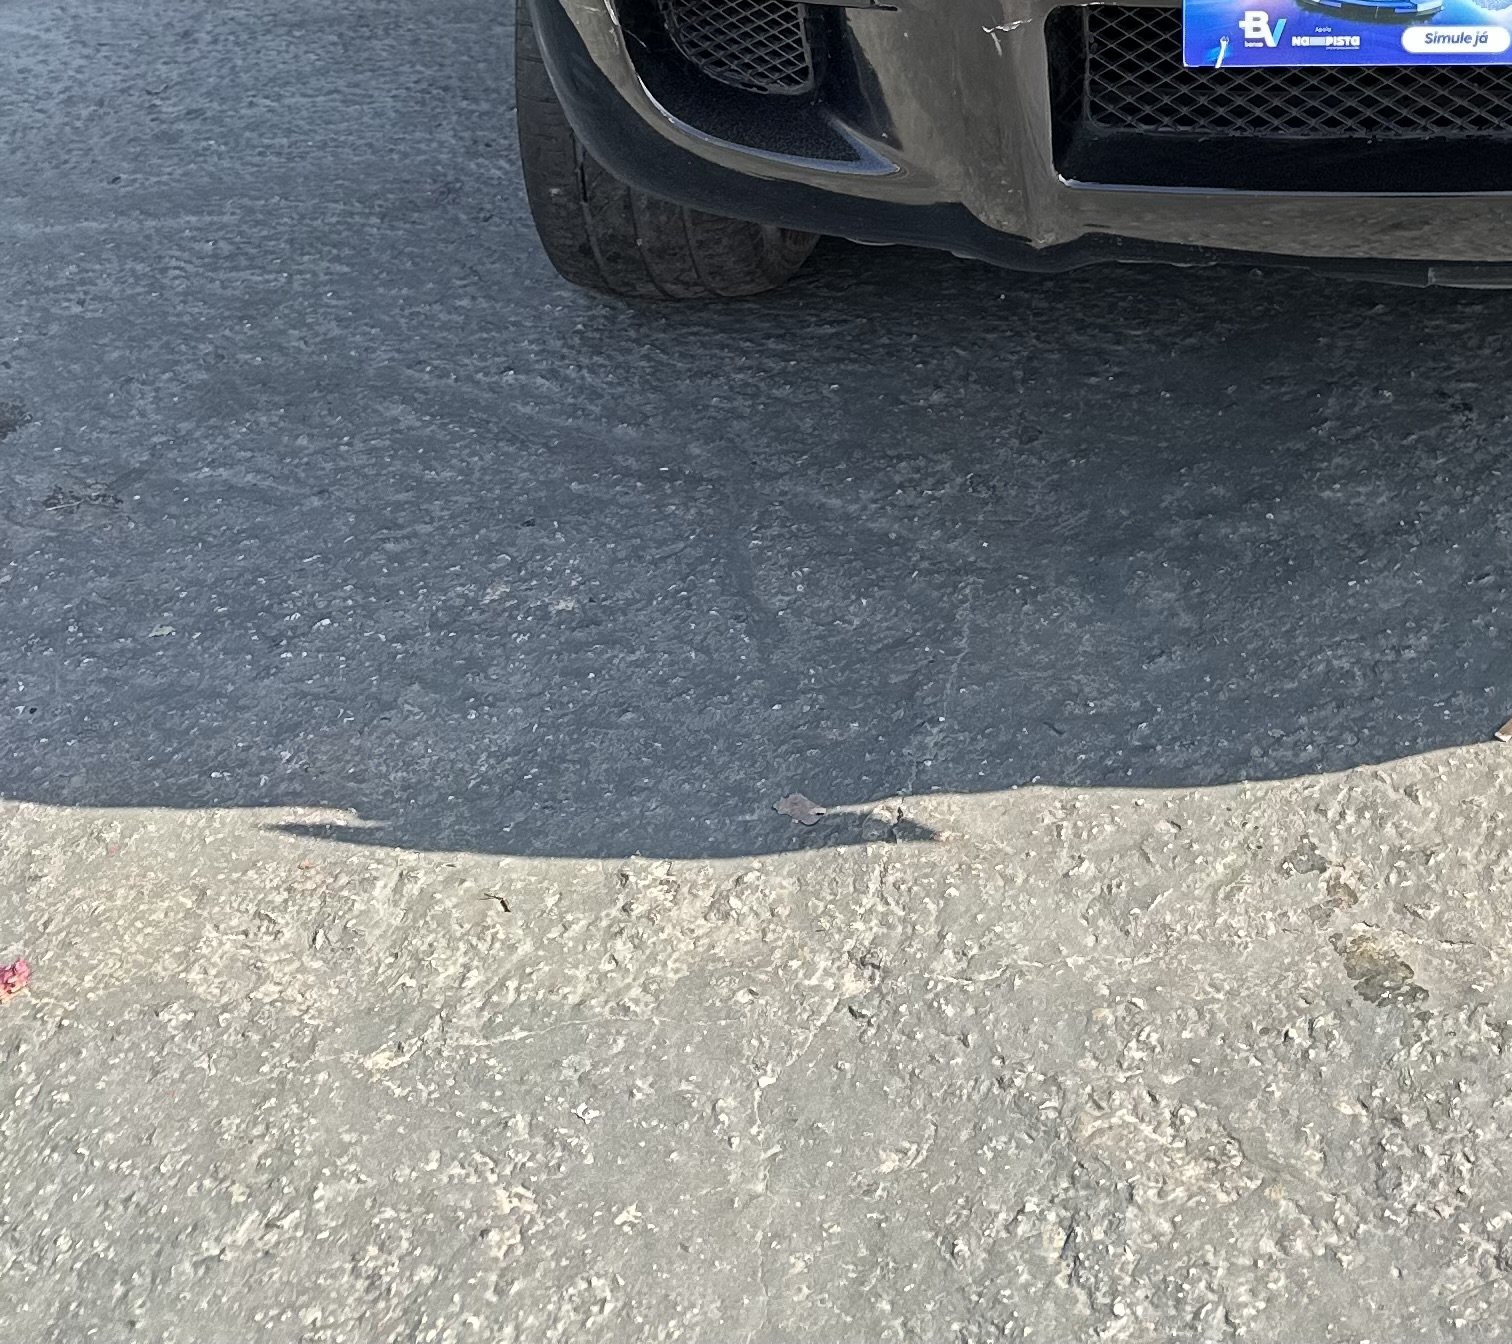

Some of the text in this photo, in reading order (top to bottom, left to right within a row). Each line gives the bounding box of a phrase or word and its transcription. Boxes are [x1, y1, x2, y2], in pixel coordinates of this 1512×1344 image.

[1239, 10, 1287, 48] BV
[1424, 31, 1489, 48] Simule já
